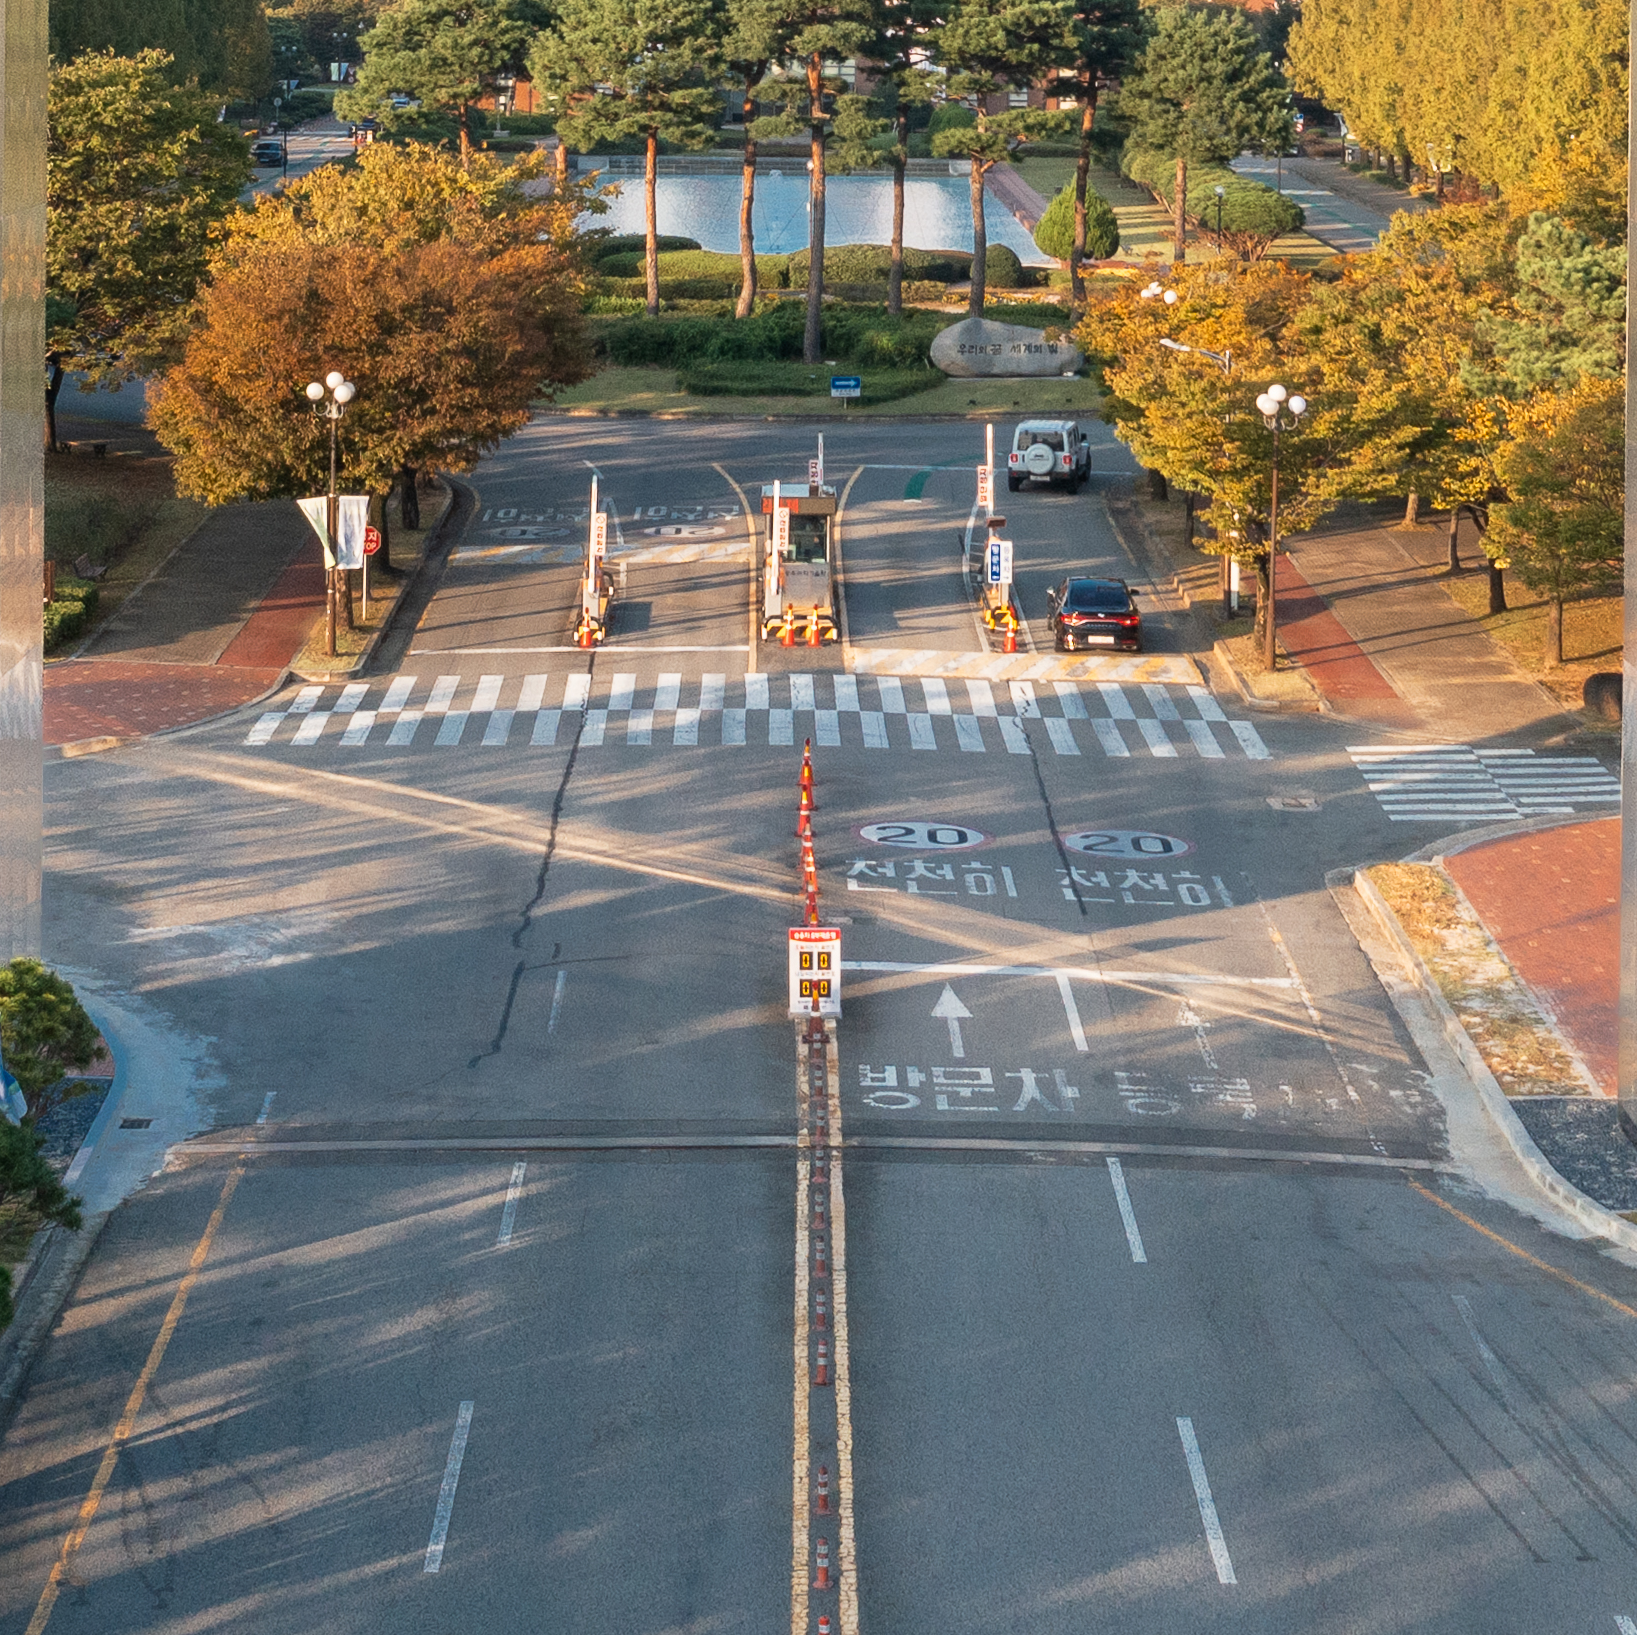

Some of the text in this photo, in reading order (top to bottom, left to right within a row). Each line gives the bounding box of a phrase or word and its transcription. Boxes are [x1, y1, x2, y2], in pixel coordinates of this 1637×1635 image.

[957, 344, 987, 355] 우리의
[876, 825, 969, 845] 20
[1079, 833, 1174, 854] 20
[845, 857, 1018, 897] 천천히
[1055, 866, 1233, 907] 천천히
[858, 1065, 1080, 1112] 방문차
